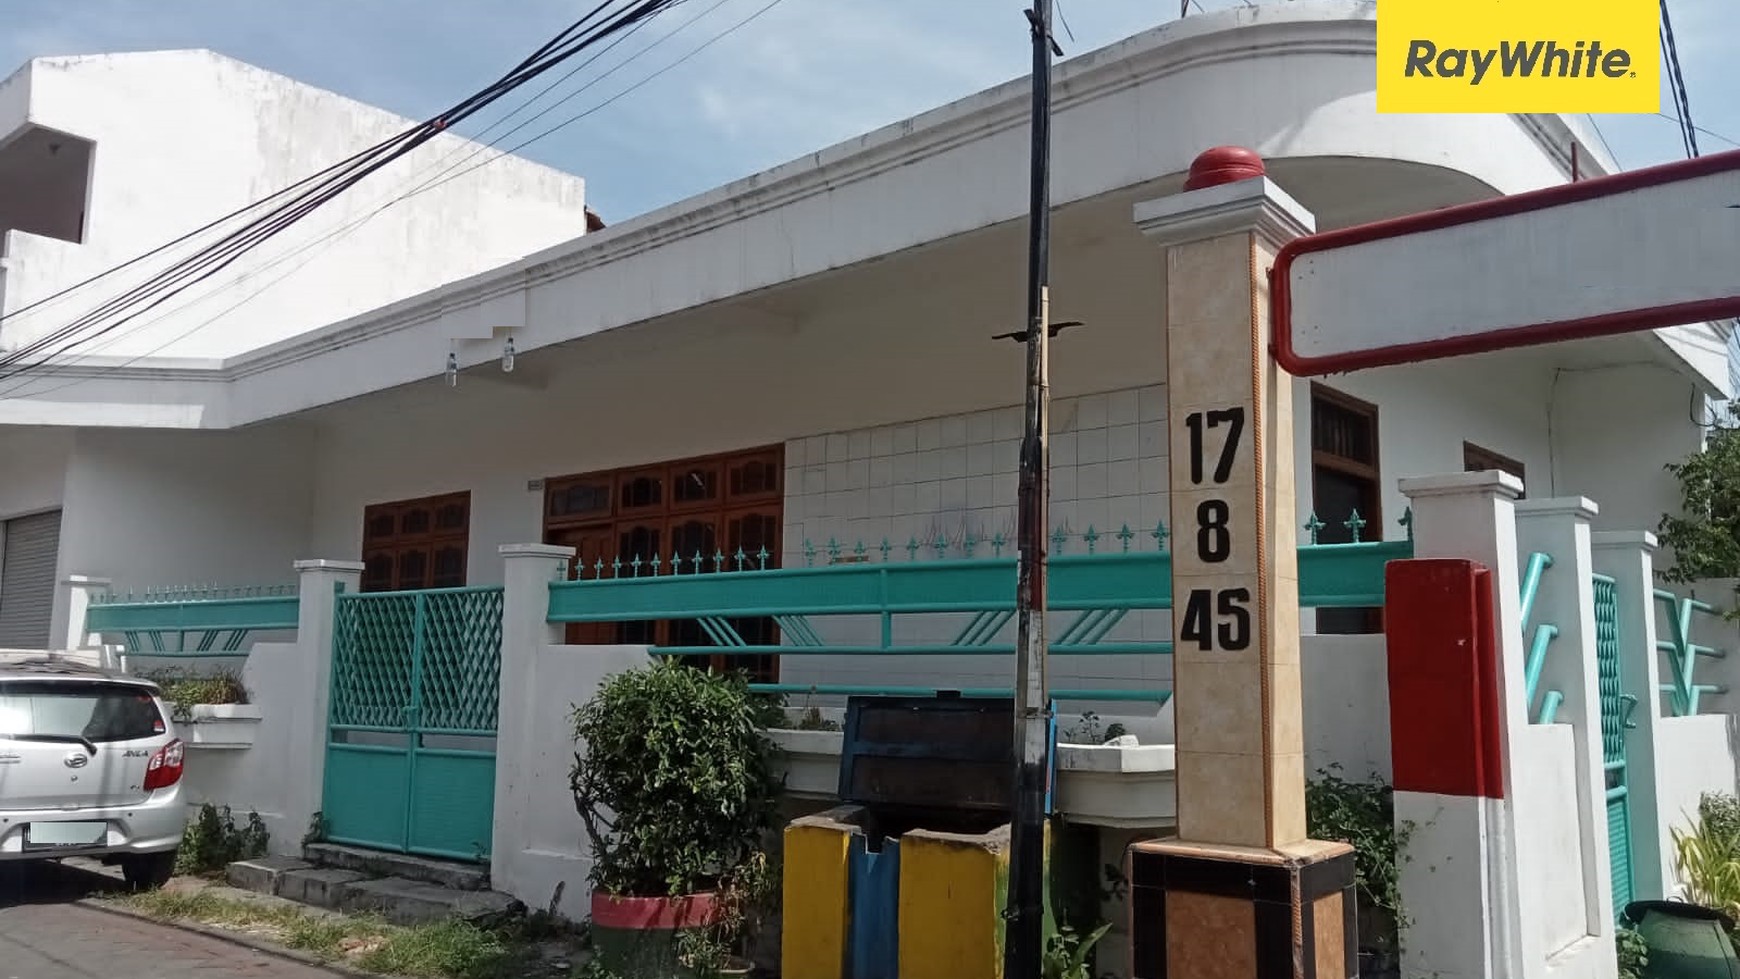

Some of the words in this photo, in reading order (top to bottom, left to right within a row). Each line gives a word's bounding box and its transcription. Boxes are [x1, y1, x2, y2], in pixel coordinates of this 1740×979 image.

[1186, 407, 1245, 484] 17
[1197, 499, 1230, 563] 8
[1181, 587, 1250, 651] 45
